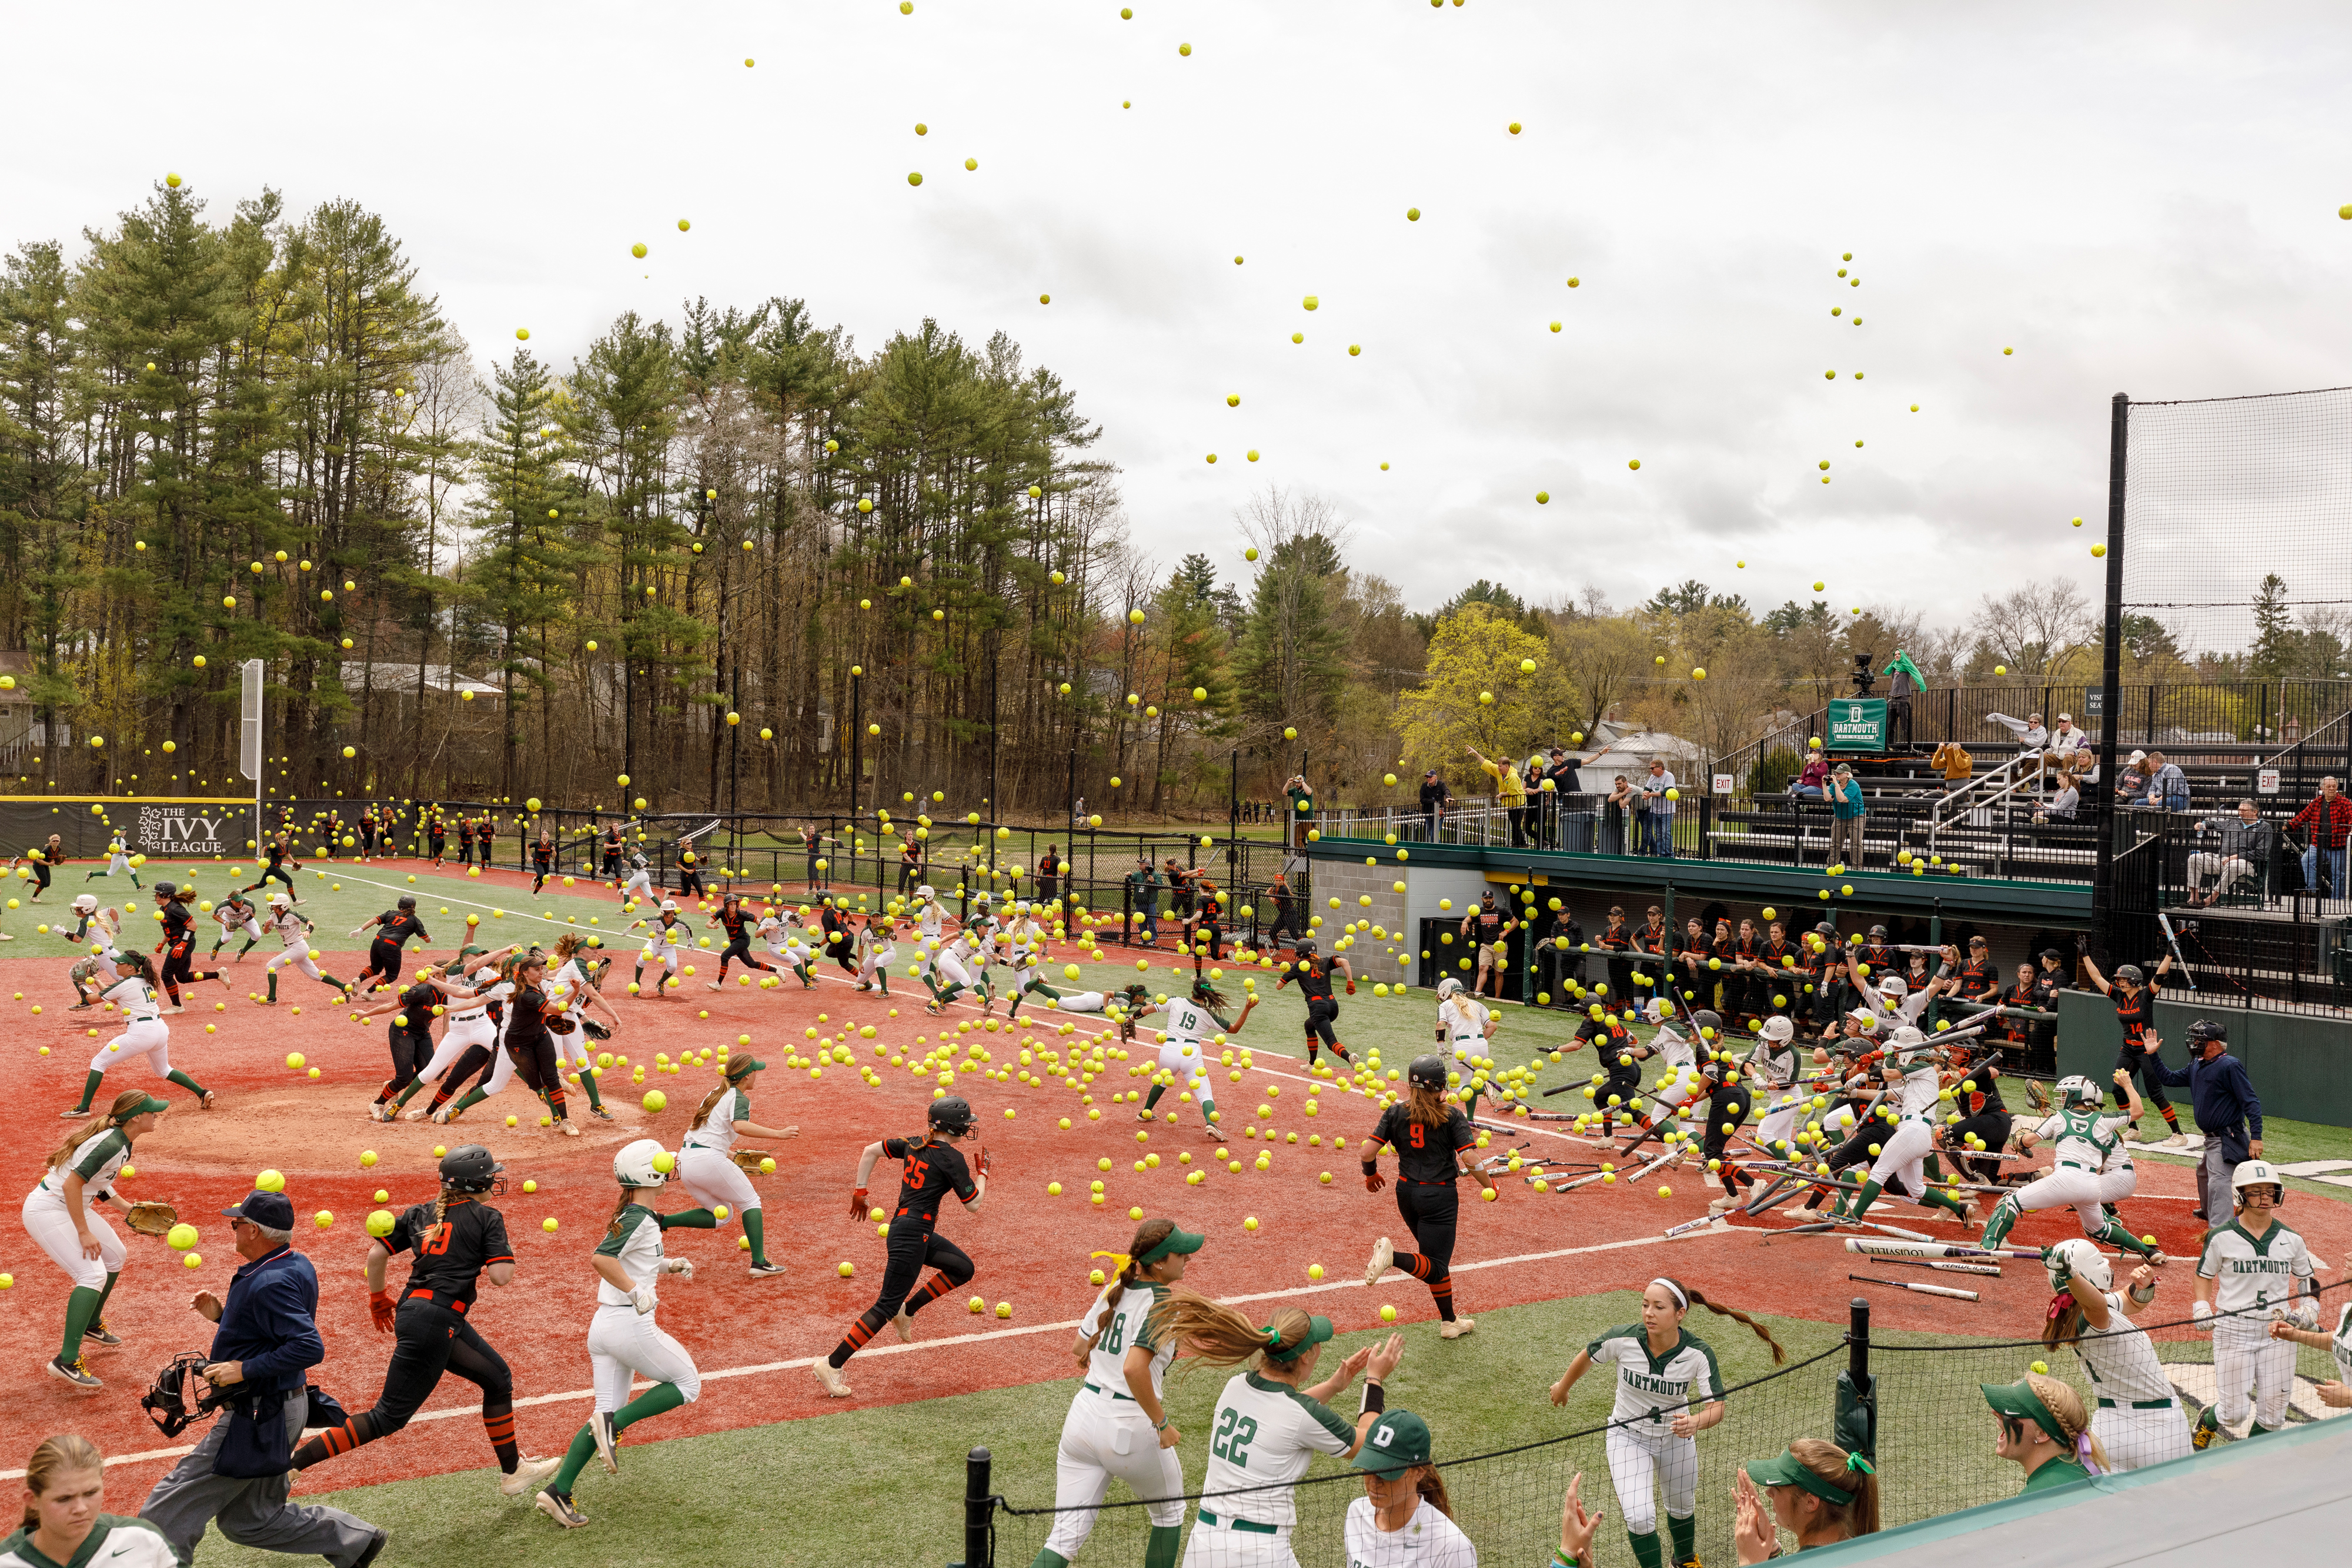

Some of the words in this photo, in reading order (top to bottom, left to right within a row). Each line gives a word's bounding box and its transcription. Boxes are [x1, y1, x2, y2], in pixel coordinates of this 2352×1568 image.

[1834, 723, 1877, 733] DARTMOUTH
[1716, 779, 1730, 788] EXIT
[2263, 776, 2277, 787] EXIT
[162, 818, 222, 840] IVY
[162, 842, 222, 852] LEAGUE
[1207, 903, 1216, 913] 25
[392, 915, 407, 926] 17
[2117, 1007, 2140, 1015] PRINCETON
[1179, 1011, 1197, 1030] 19
[2130, 1022, 2143, 1034] 14
[1409, 1124, 1425, 1148] 9
[1970, 1152, 2017, 1161] RAWLINGS
[903, 1155, 929, 1189] 25
[2254, 1166, 2267, 1178] D
[1896, 1227, 1923, 1237] LOUISVILLE
[1869, 1246, 1925, 1257] LOUISVILLE
[1942, 1262, 1998, 1272] RAWLINGS
[2233, 1259, 2289, 1274] DARTMOUTH
[2256, 1290, 2268, 1310] 5
[1098, 1310, 1126, 1355] 18
[1623, 1368, 1690, 1396] DARTMOUTH
[1644, 1405, 1662, 1424] 4
[1213, 1407, 1258, 1468] 22
[1373, 1425, 1395, 1447] D
[1826, 1495, 1843, 1504] DRI-FIT
